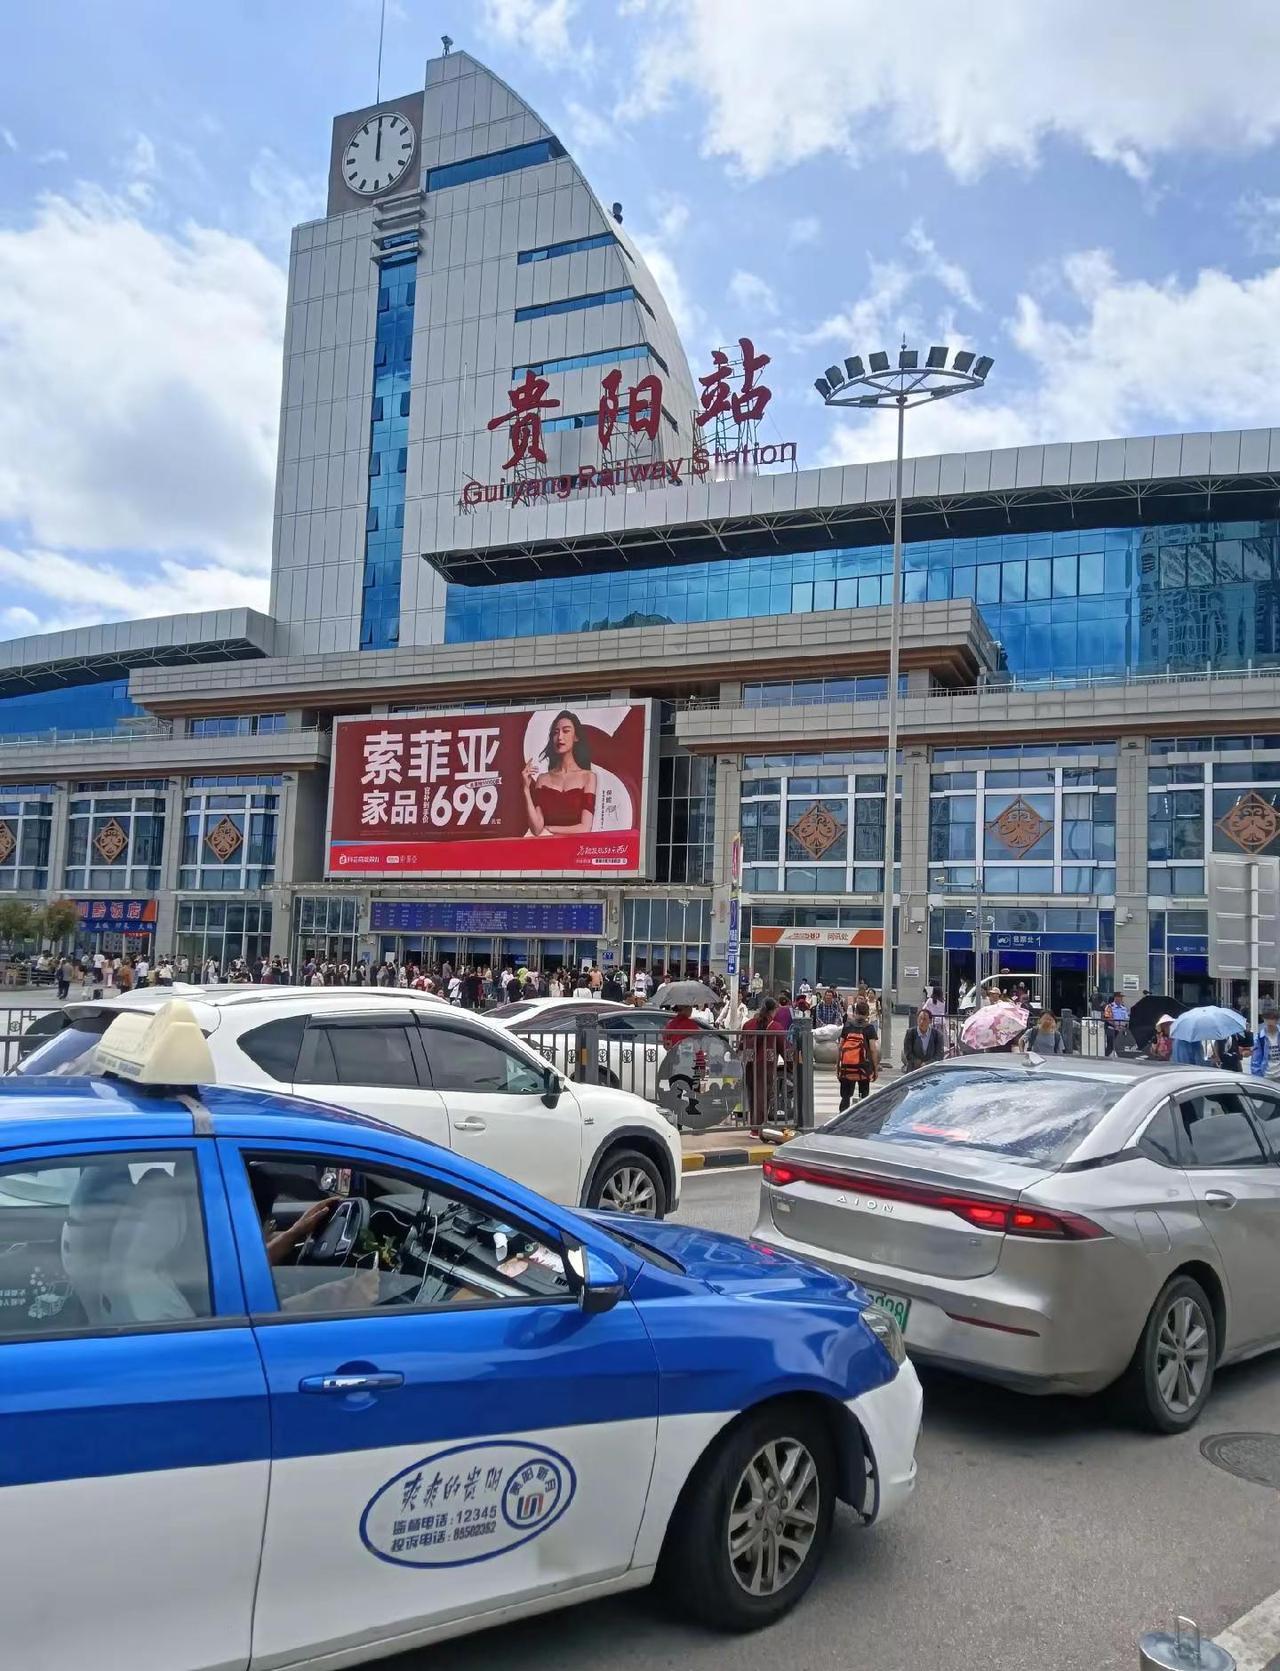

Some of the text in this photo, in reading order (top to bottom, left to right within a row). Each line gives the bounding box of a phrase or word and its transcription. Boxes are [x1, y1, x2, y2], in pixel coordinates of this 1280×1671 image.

[487, 338, 772, 470] 贵阳站
[578, 457, 684, 491] Railway
[693, 442, 797, 474] Station
[361, 728, 500, 785] 索菲亚
[361, 789, 418, 825] 家品
[430, 784, 499, 827] 699
[836, 1195, 894, 1213] AION
[401, 1465, 504, 1513] 爽爽的贵阳
